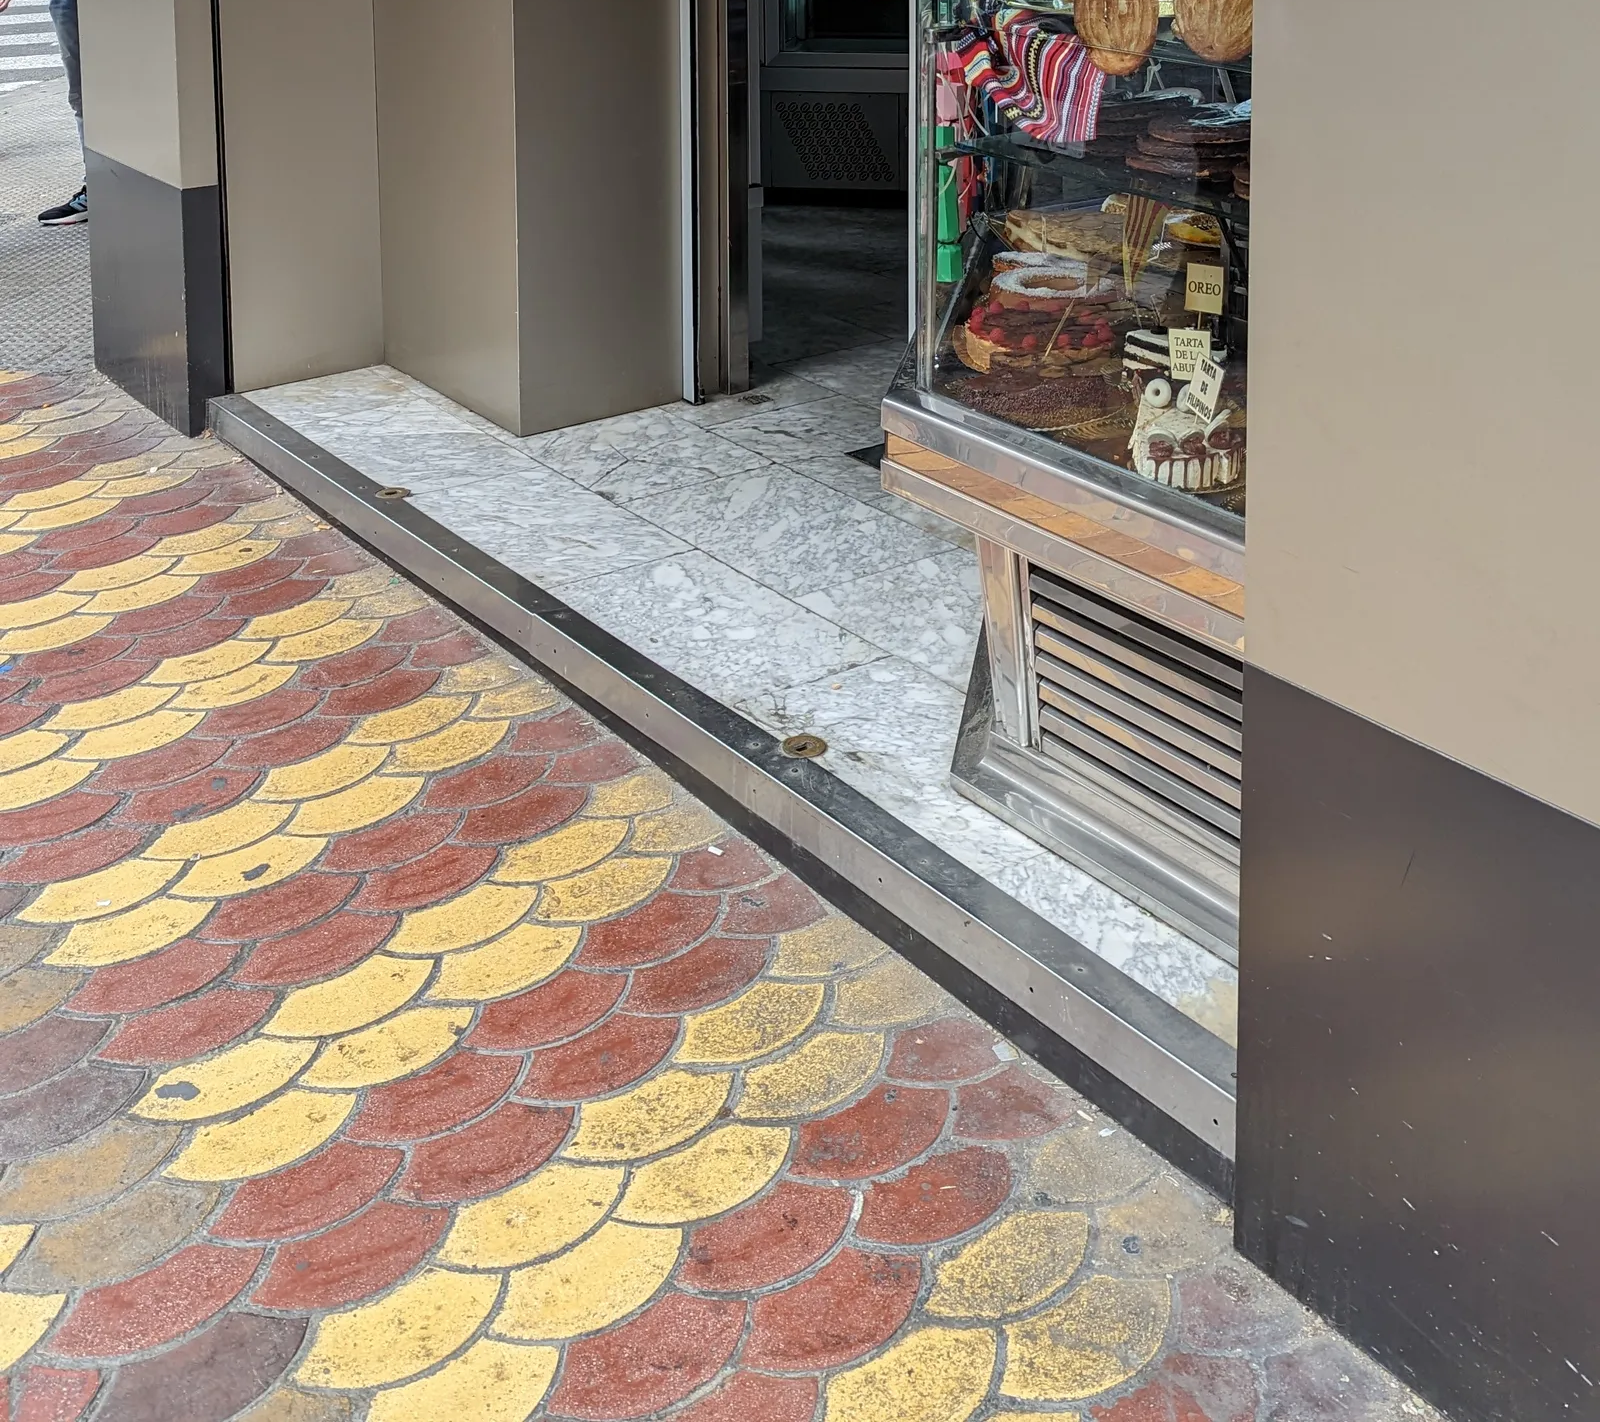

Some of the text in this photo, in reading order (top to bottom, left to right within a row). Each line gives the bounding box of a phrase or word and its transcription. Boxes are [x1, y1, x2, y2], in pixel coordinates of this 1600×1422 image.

[1188, 280, 1222, 296] OREO
[1174, 336, 1204, 348] TARTA
[1175, 349, 1198, 360] DE L
[1200, 358, 1217, 381] TARTA
[1200, 380, 1209, 395] DE
[1186, 392, 1212, 420] FILIPINOS
